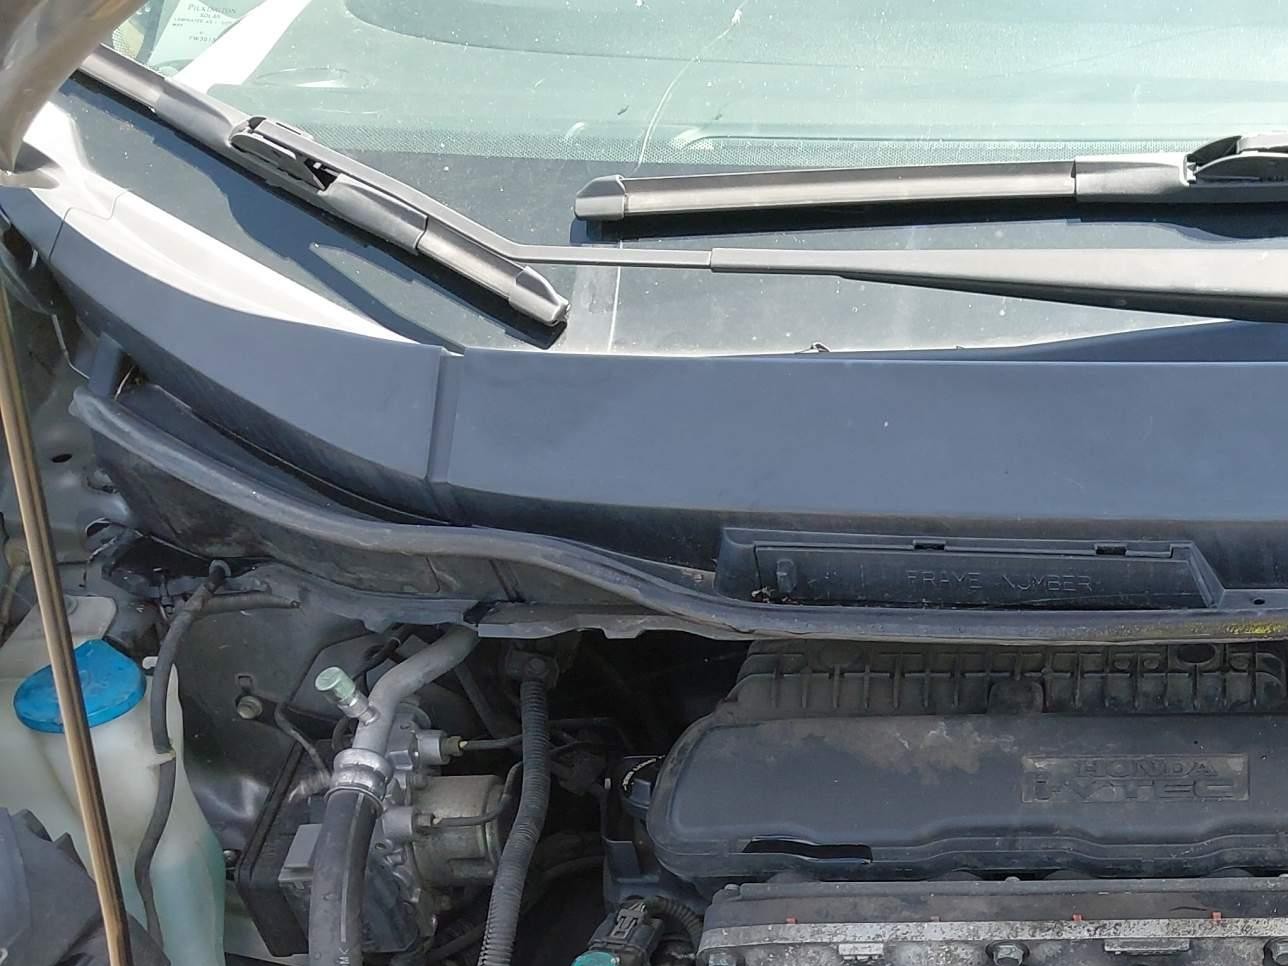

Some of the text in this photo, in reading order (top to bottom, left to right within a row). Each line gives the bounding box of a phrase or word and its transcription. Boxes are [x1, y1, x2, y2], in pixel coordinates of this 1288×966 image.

[905, 570, 1092, 592] FRAME NUMBER
[1077, 759, 1218, 778] HONDA
